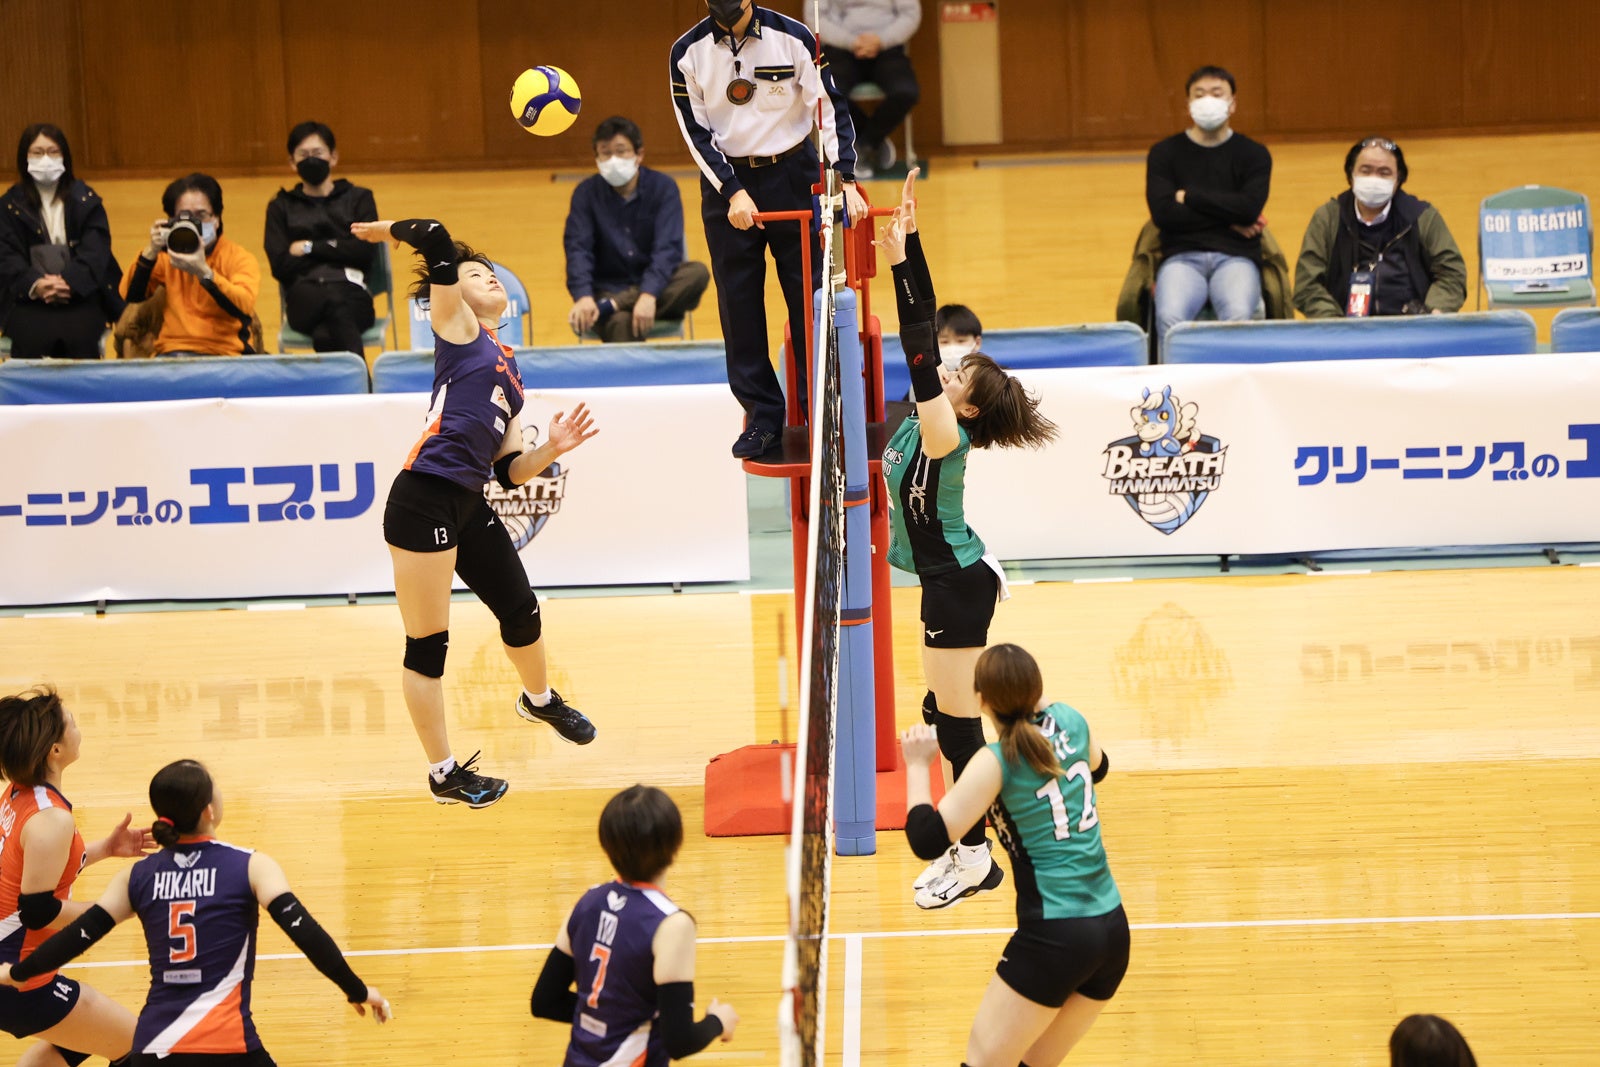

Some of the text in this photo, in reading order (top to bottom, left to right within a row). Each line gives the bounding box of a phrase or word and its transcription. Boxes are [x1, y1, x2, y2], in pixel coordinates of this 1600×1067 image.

[1484, 209, 1584, 233] GO! BREATH!
[1102, 445, 1227, 479] BREATH
[1110, 476, 1220, 494] HAMAMATSU
[488, 500, 560, 515] AMATSU
[433, 527, 449, 545] 13
[1035, 760, 1099, 842] 12
[152, 868, 217, 900] HIKARU
[169, 900, 197, 963] 5
[587, 942, 612, 1009] 7
[53, 982, 73, 1002] 14
